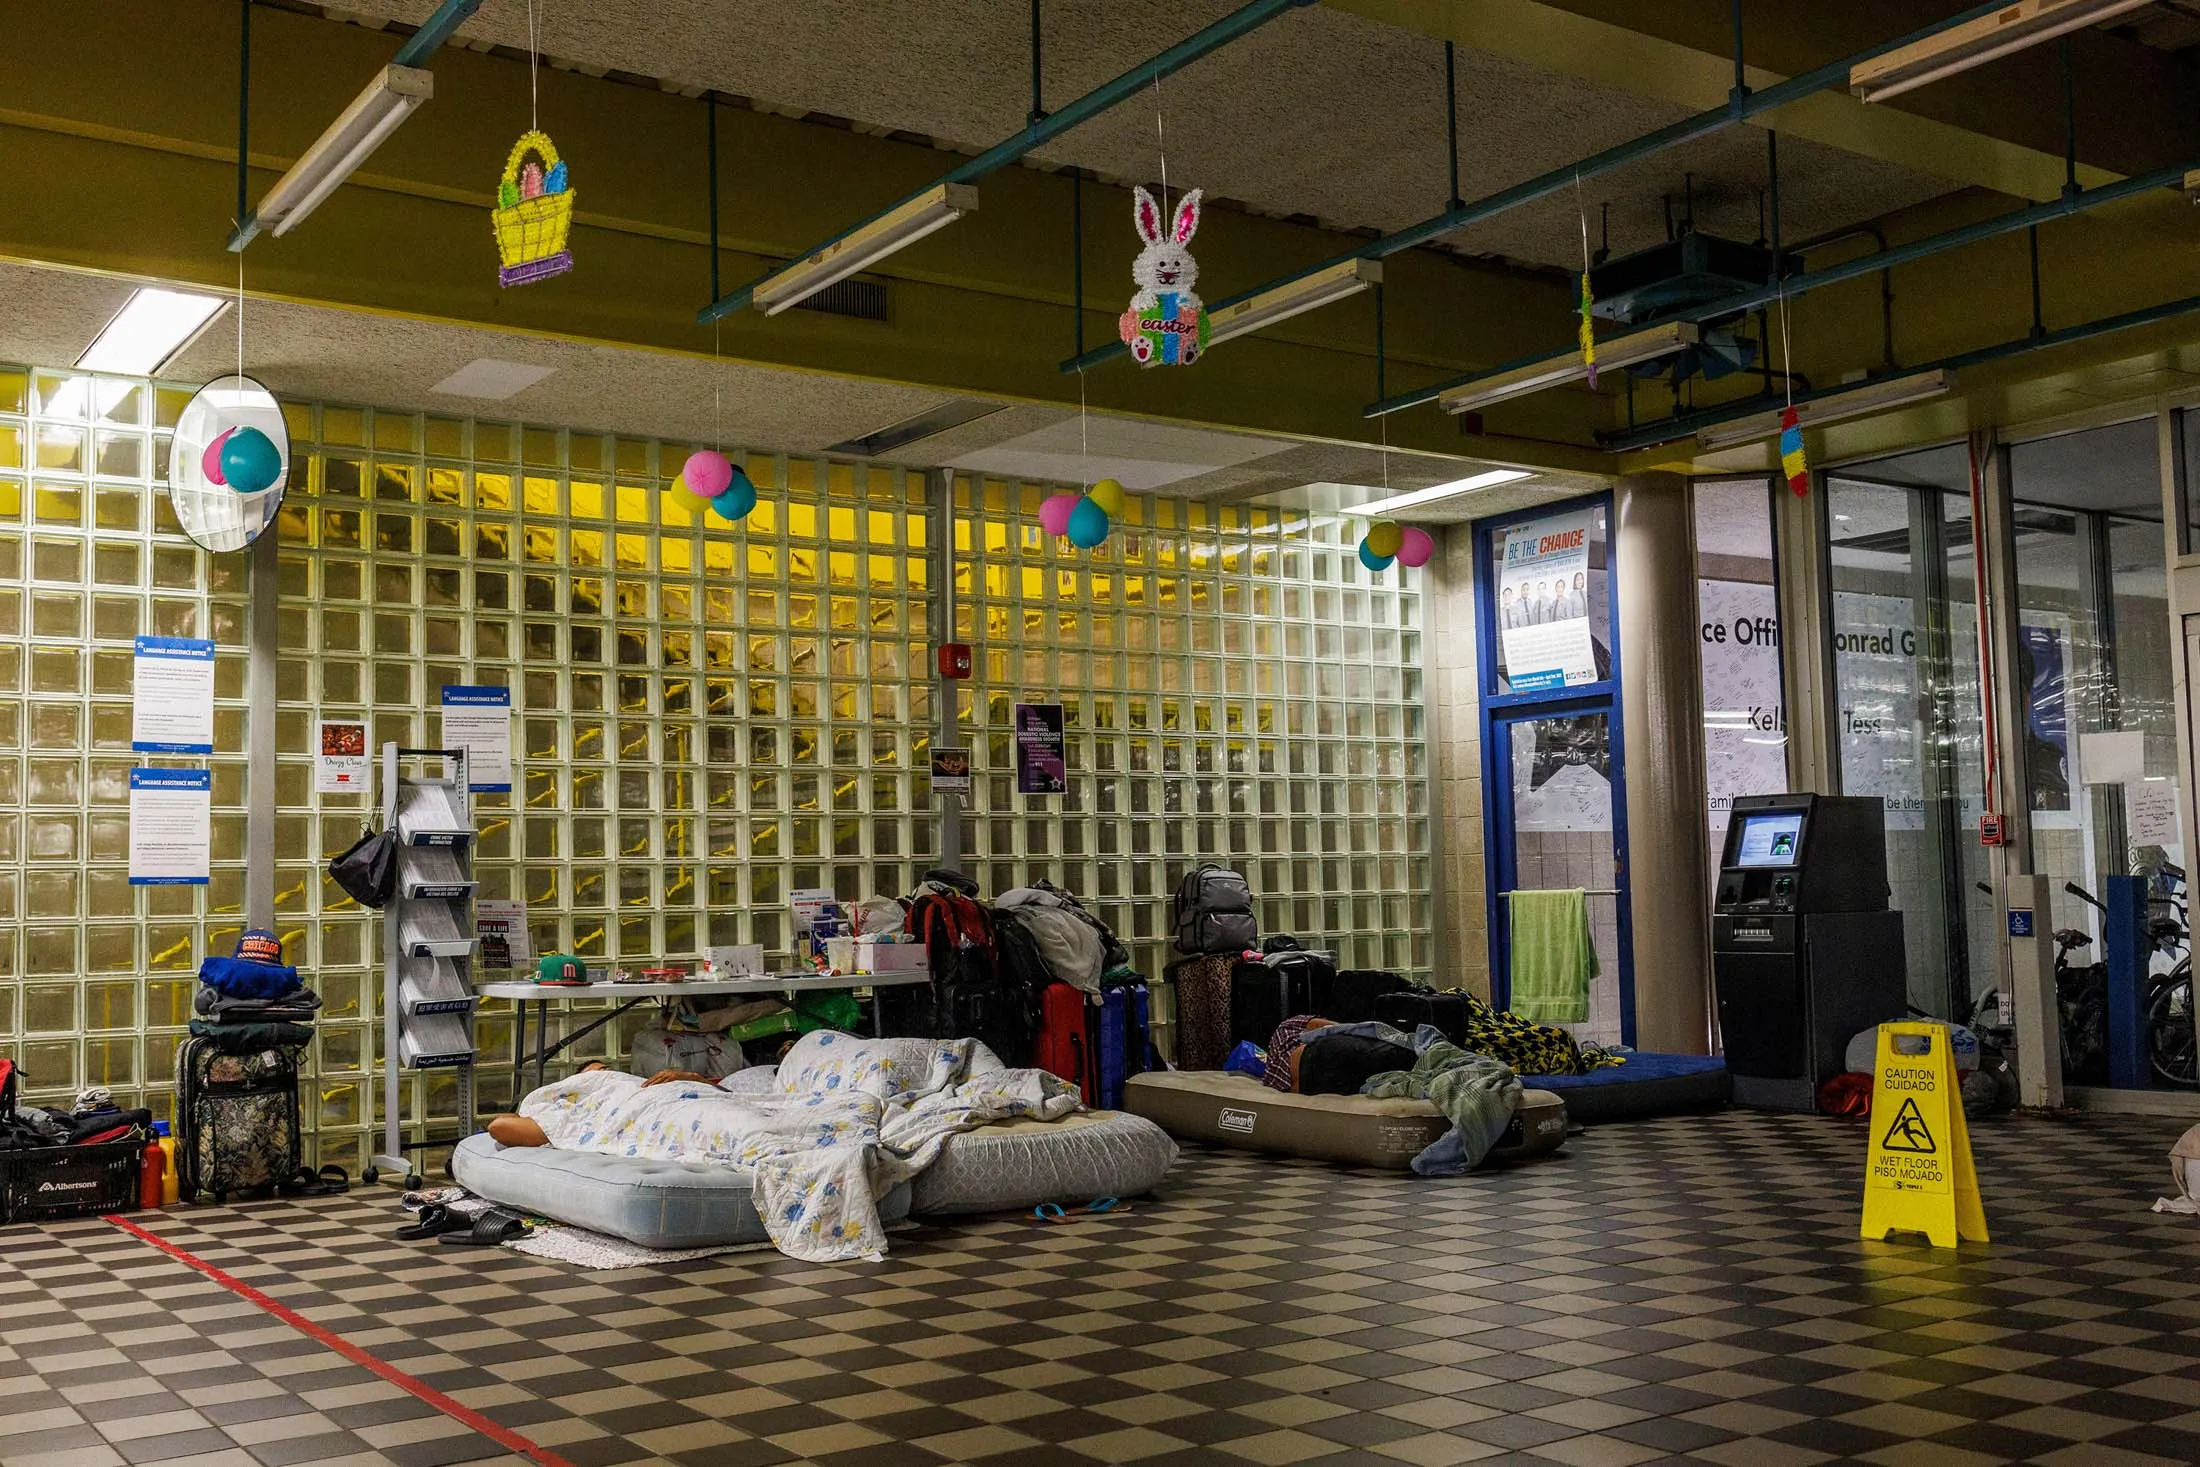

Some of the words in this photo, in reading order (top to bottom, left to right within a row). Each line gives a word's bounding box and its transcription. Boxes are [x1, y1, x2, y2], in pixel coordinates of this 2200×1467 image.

[1141, 318, 1196, 334] easter
[1508, 542, 1520, 560] BE
[1522, 539, 1537, 557] THE
[1539, 528, 1585, 553] CHANGE
[1886, 794, 1900, 809] be
[243, 940, 279, 955] CHICAGO
[1885, 1067, 1935, 1080] CAUTION
[1884, 1079, 1935, 1092] CUIDADO
[1222, 1111, 1248, 1126] Coleman
[1880, 1155, 1901, 1166] WET
[1904, 1157, 1938, 1169] FLOOR
[1874, 1166, 1897, 1177] PISO
[1900, 1168, 1943, 1182] MOJADO
[55, 1181, 98, 1190] Albertsons
